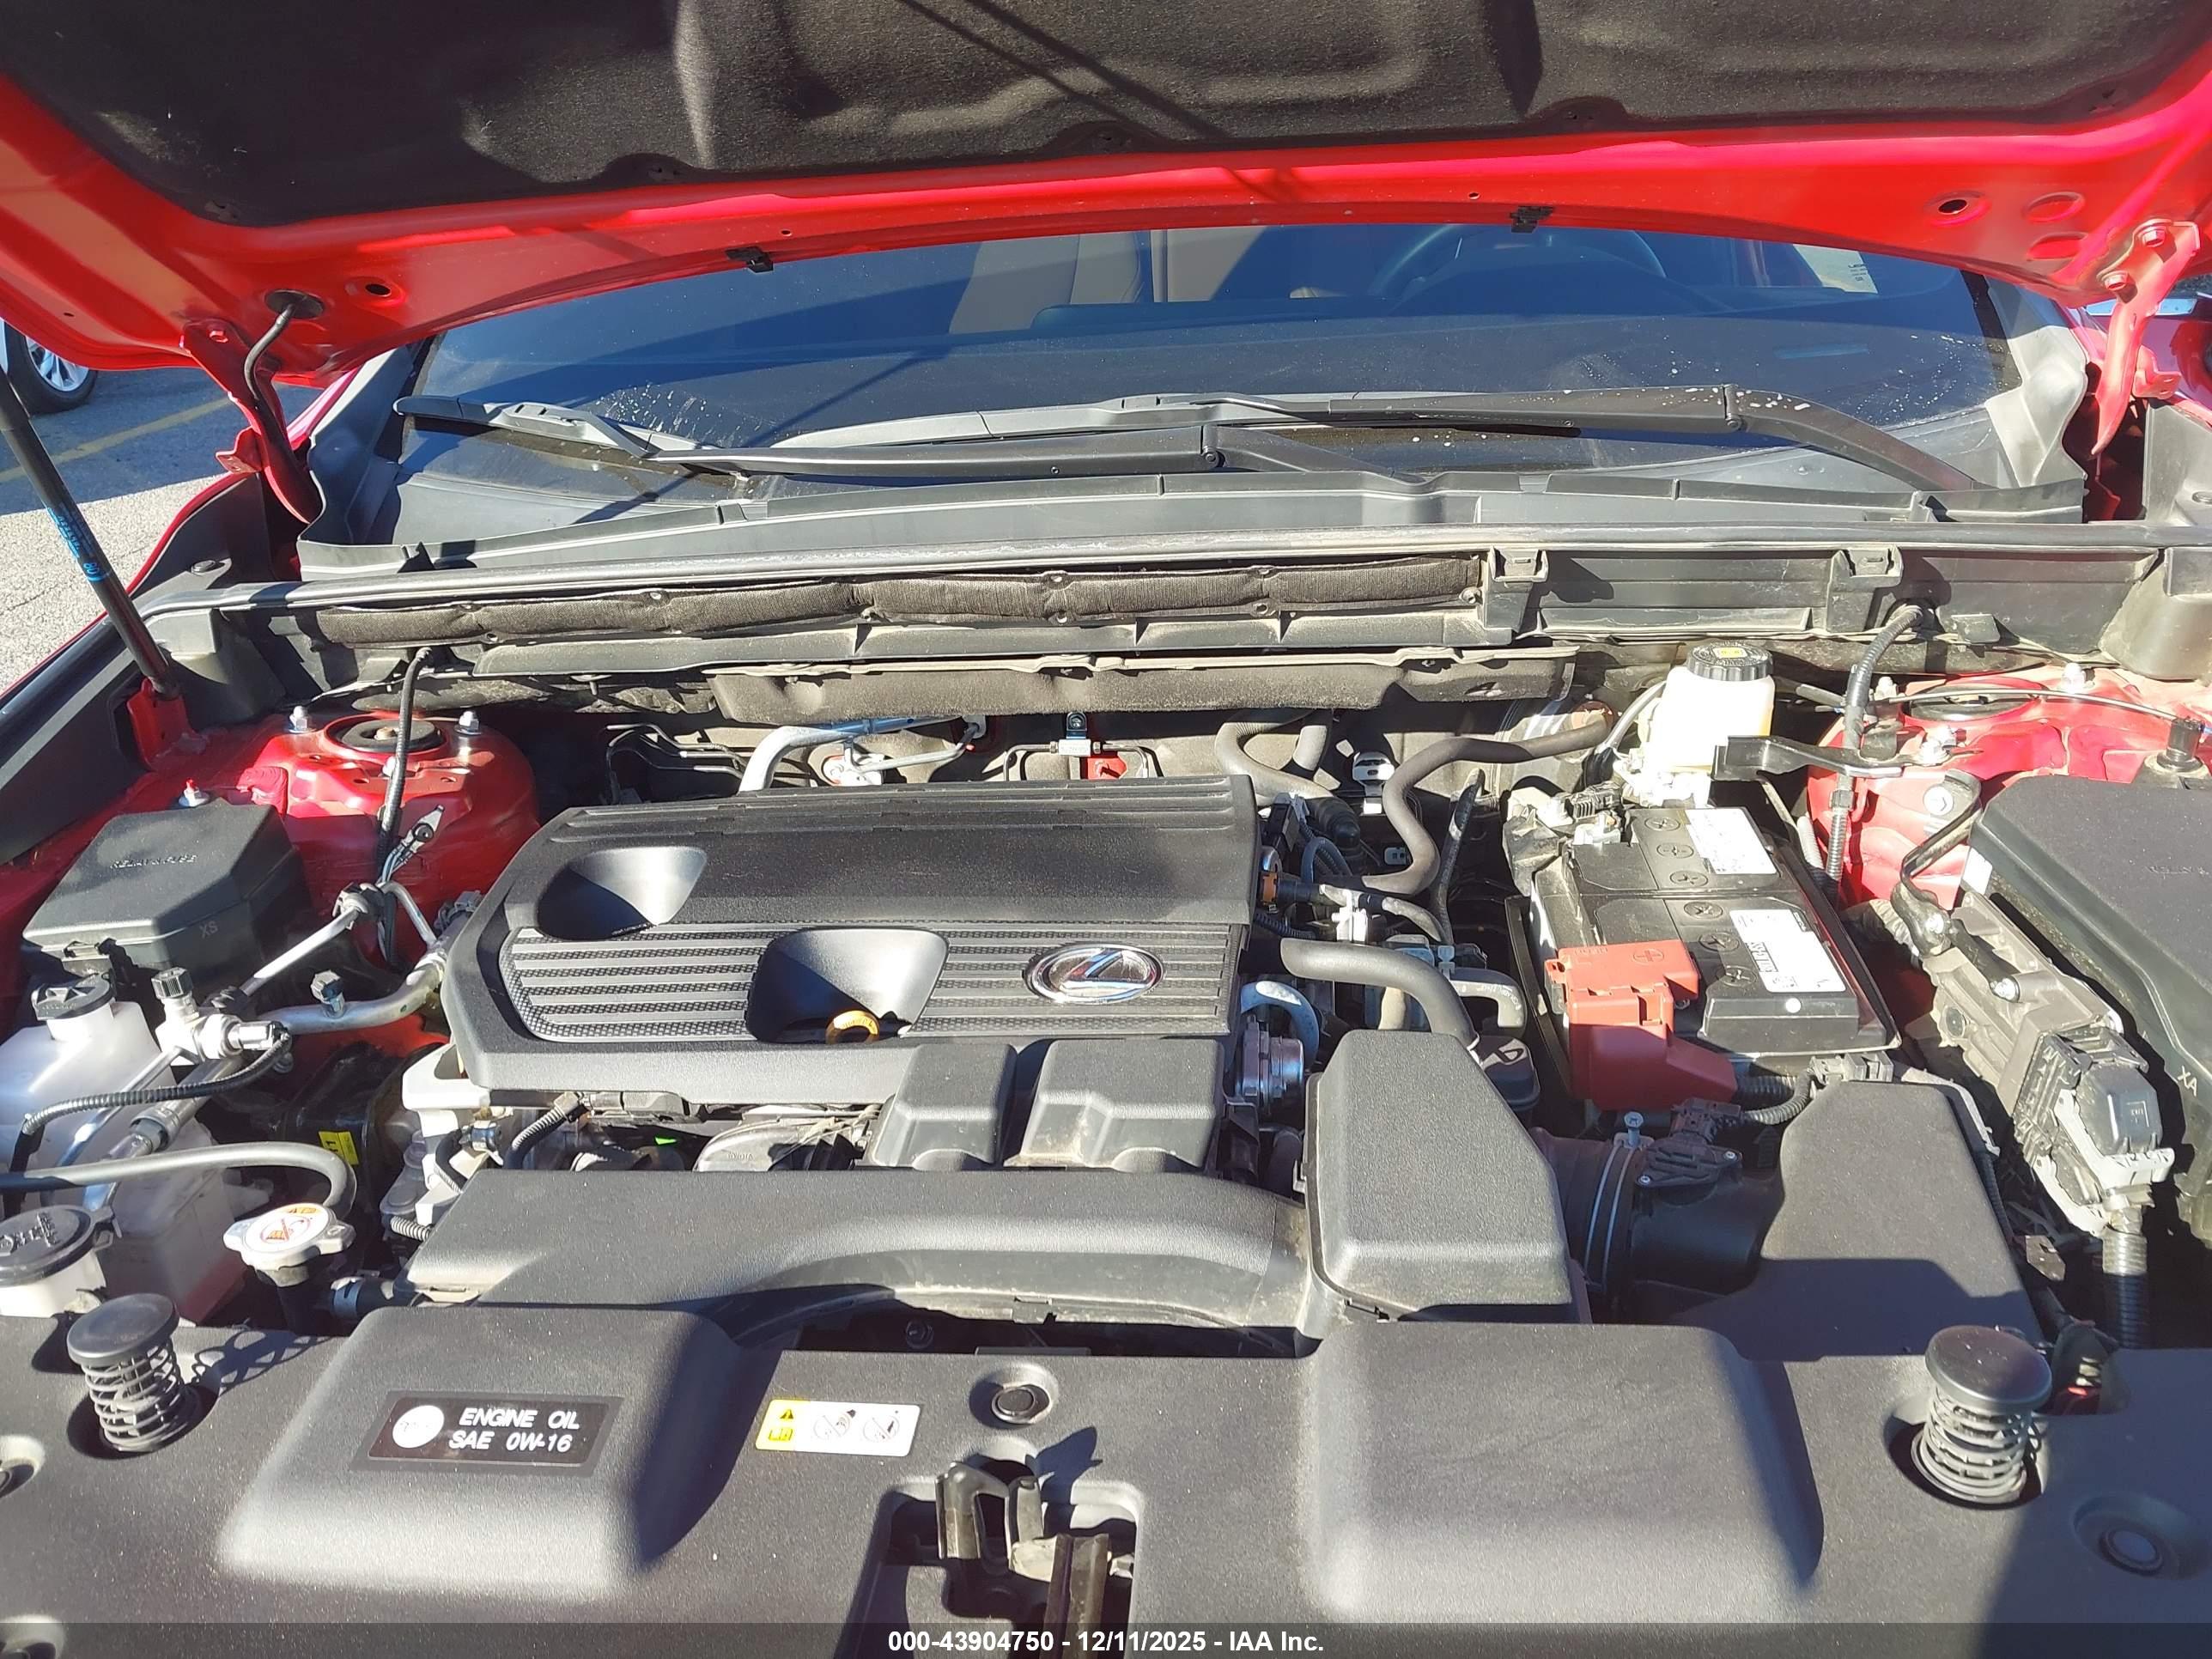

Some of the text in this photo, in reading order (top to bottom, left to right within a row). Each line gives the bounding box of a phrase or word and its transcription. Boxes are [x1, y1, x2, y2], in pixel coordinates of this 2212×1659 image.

[199, 921, 219, 939] XS
[2177, 1065, 2198, 1097] XA
[459, 1407, 580, 1430] ENGINE OIL
[448, 1429, 574, 1453] SAE 0W-16
